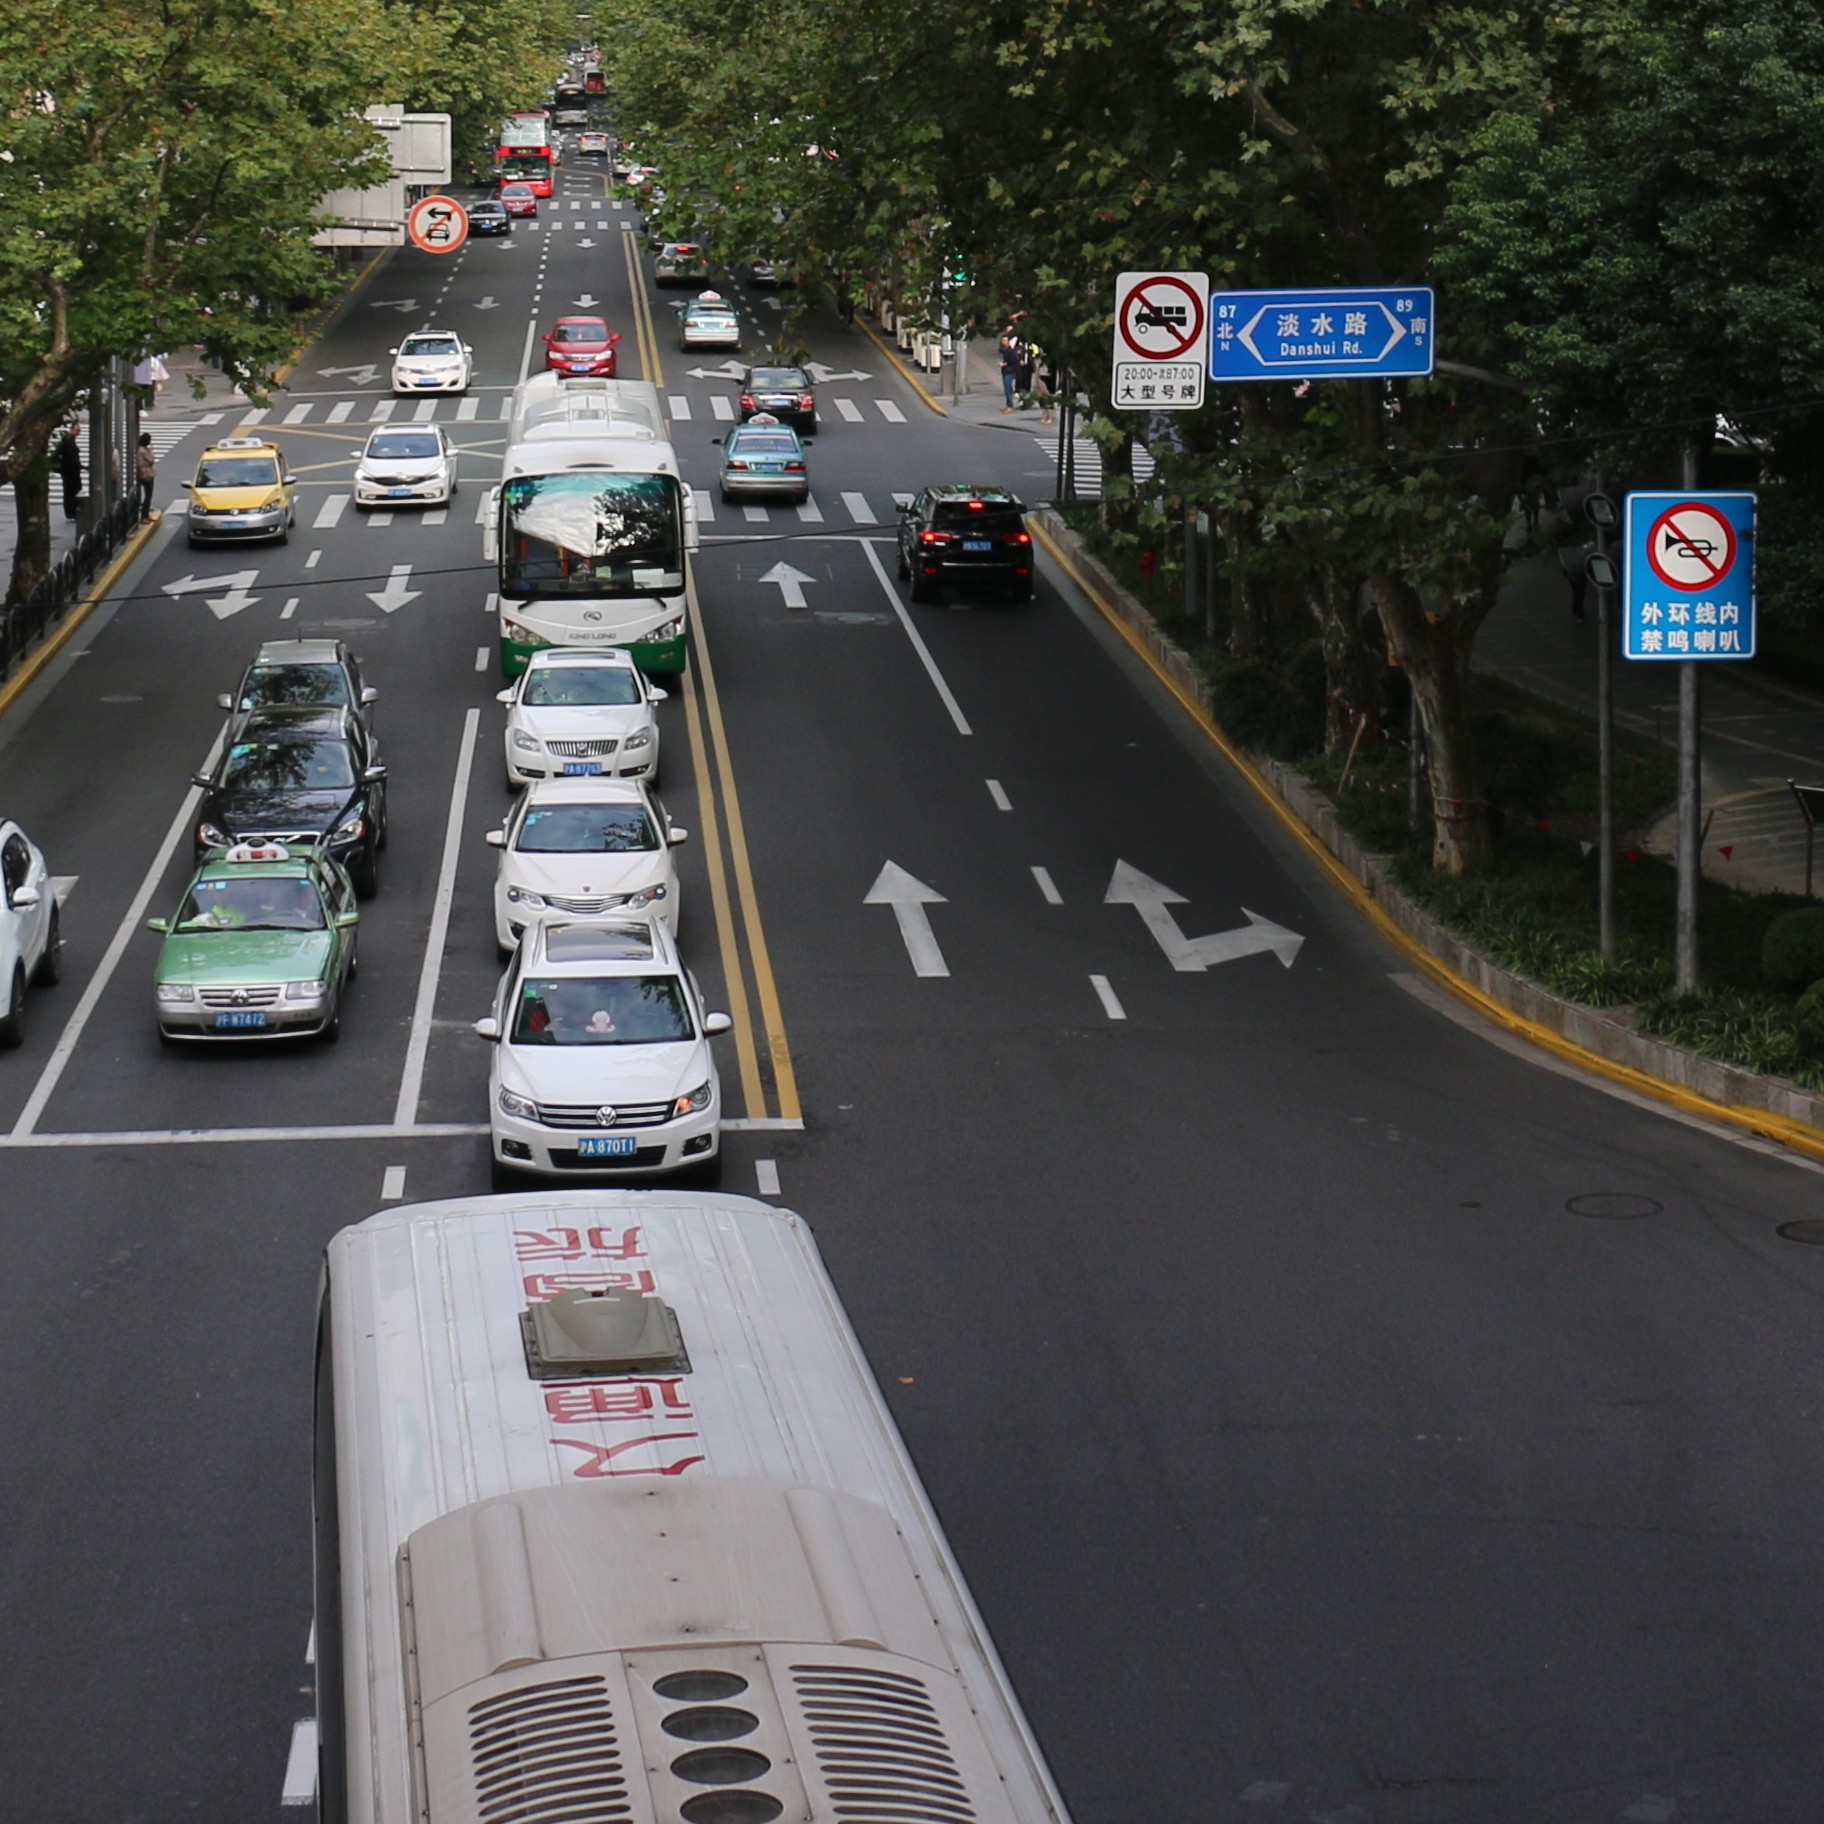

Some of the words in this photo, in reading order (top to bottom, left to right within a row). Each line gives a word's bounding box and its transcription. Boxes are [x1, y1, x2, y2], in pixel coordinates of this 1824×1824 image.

[1219, 305, 1236, 319] 87
[1396, 299, 1413, 313] 89
[1217, 323, 1233, 339] 北
[1276, 312, 1368, 337] 淡水路
[1410, 317, 1426, 334] 南
[1221, 341, 1229, 351] N
[1280, 342, 1336, 357] Danshui
[1343, 340, 1362, 355] Rd.
[1414, 336, 1422, 346] S
[1121, 384, 1196, 399] 大型号牌
[1641, 601, 1739, 625] 外环线内
[1641, 629, 1741, 652] 禁鸣喇叭
